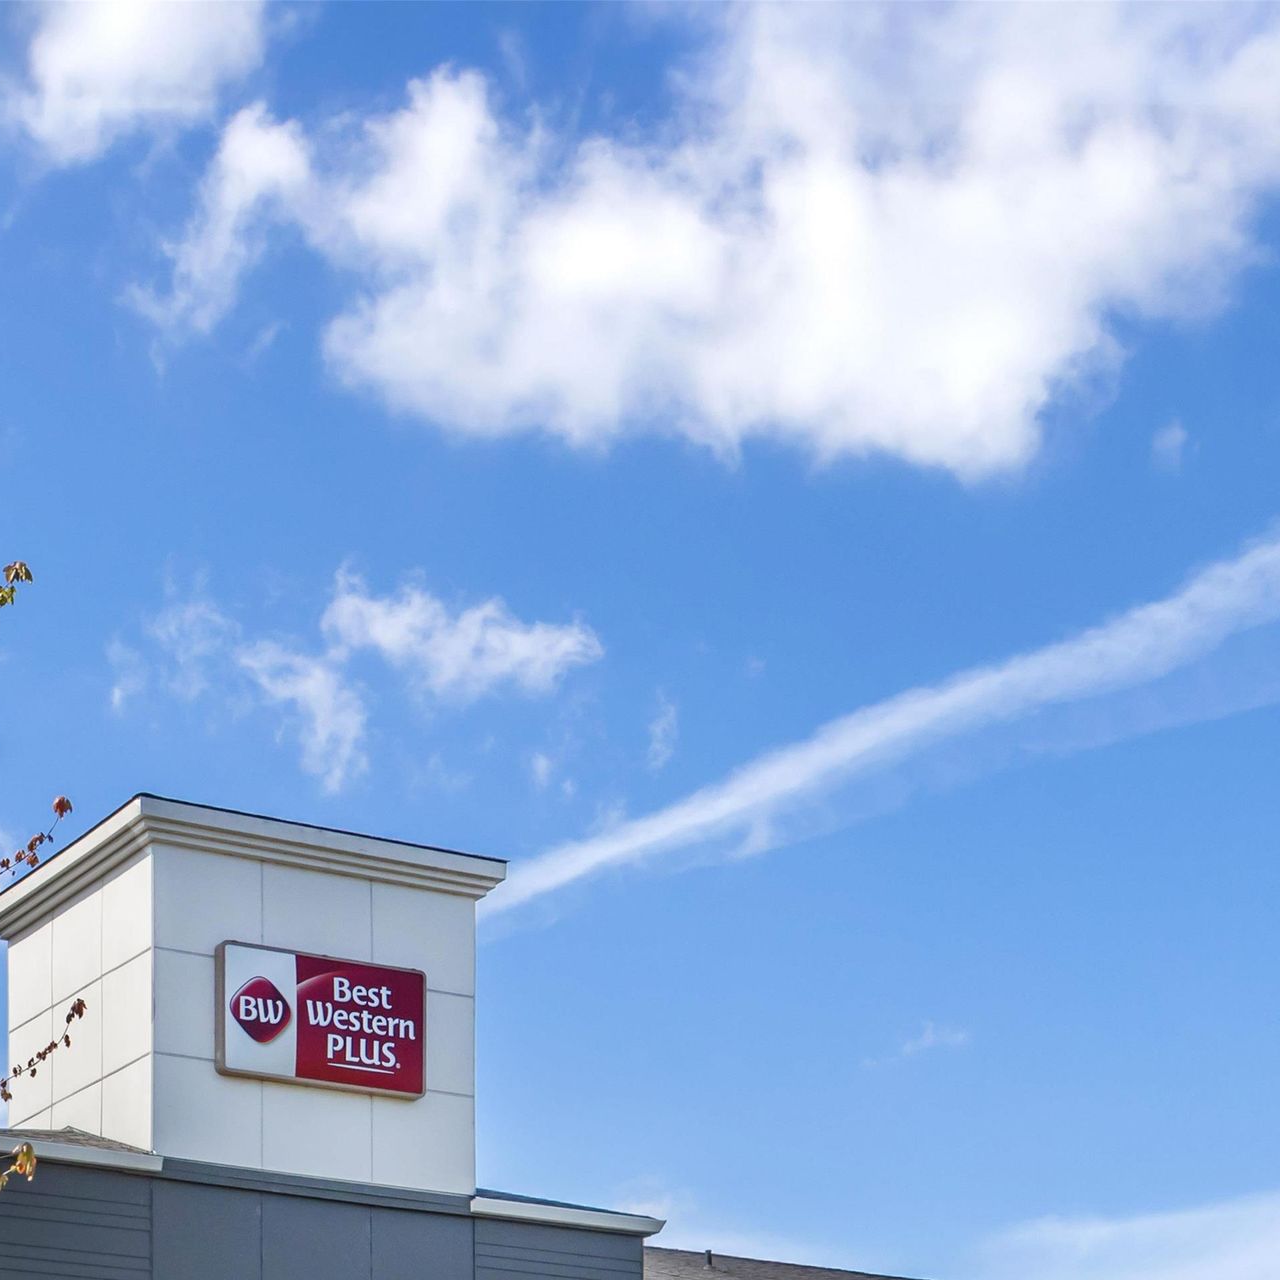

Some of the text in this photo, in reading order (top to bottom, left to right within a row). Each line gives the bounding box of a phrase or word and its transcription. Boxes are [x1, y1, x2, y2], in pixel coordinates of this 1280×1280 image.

[239, 995, 284, 1025] BW
[333, 977, 392, 1010] Best
[306, 999, 416, 1040] Western
[327, 1033, 396, 1068] PLUS
